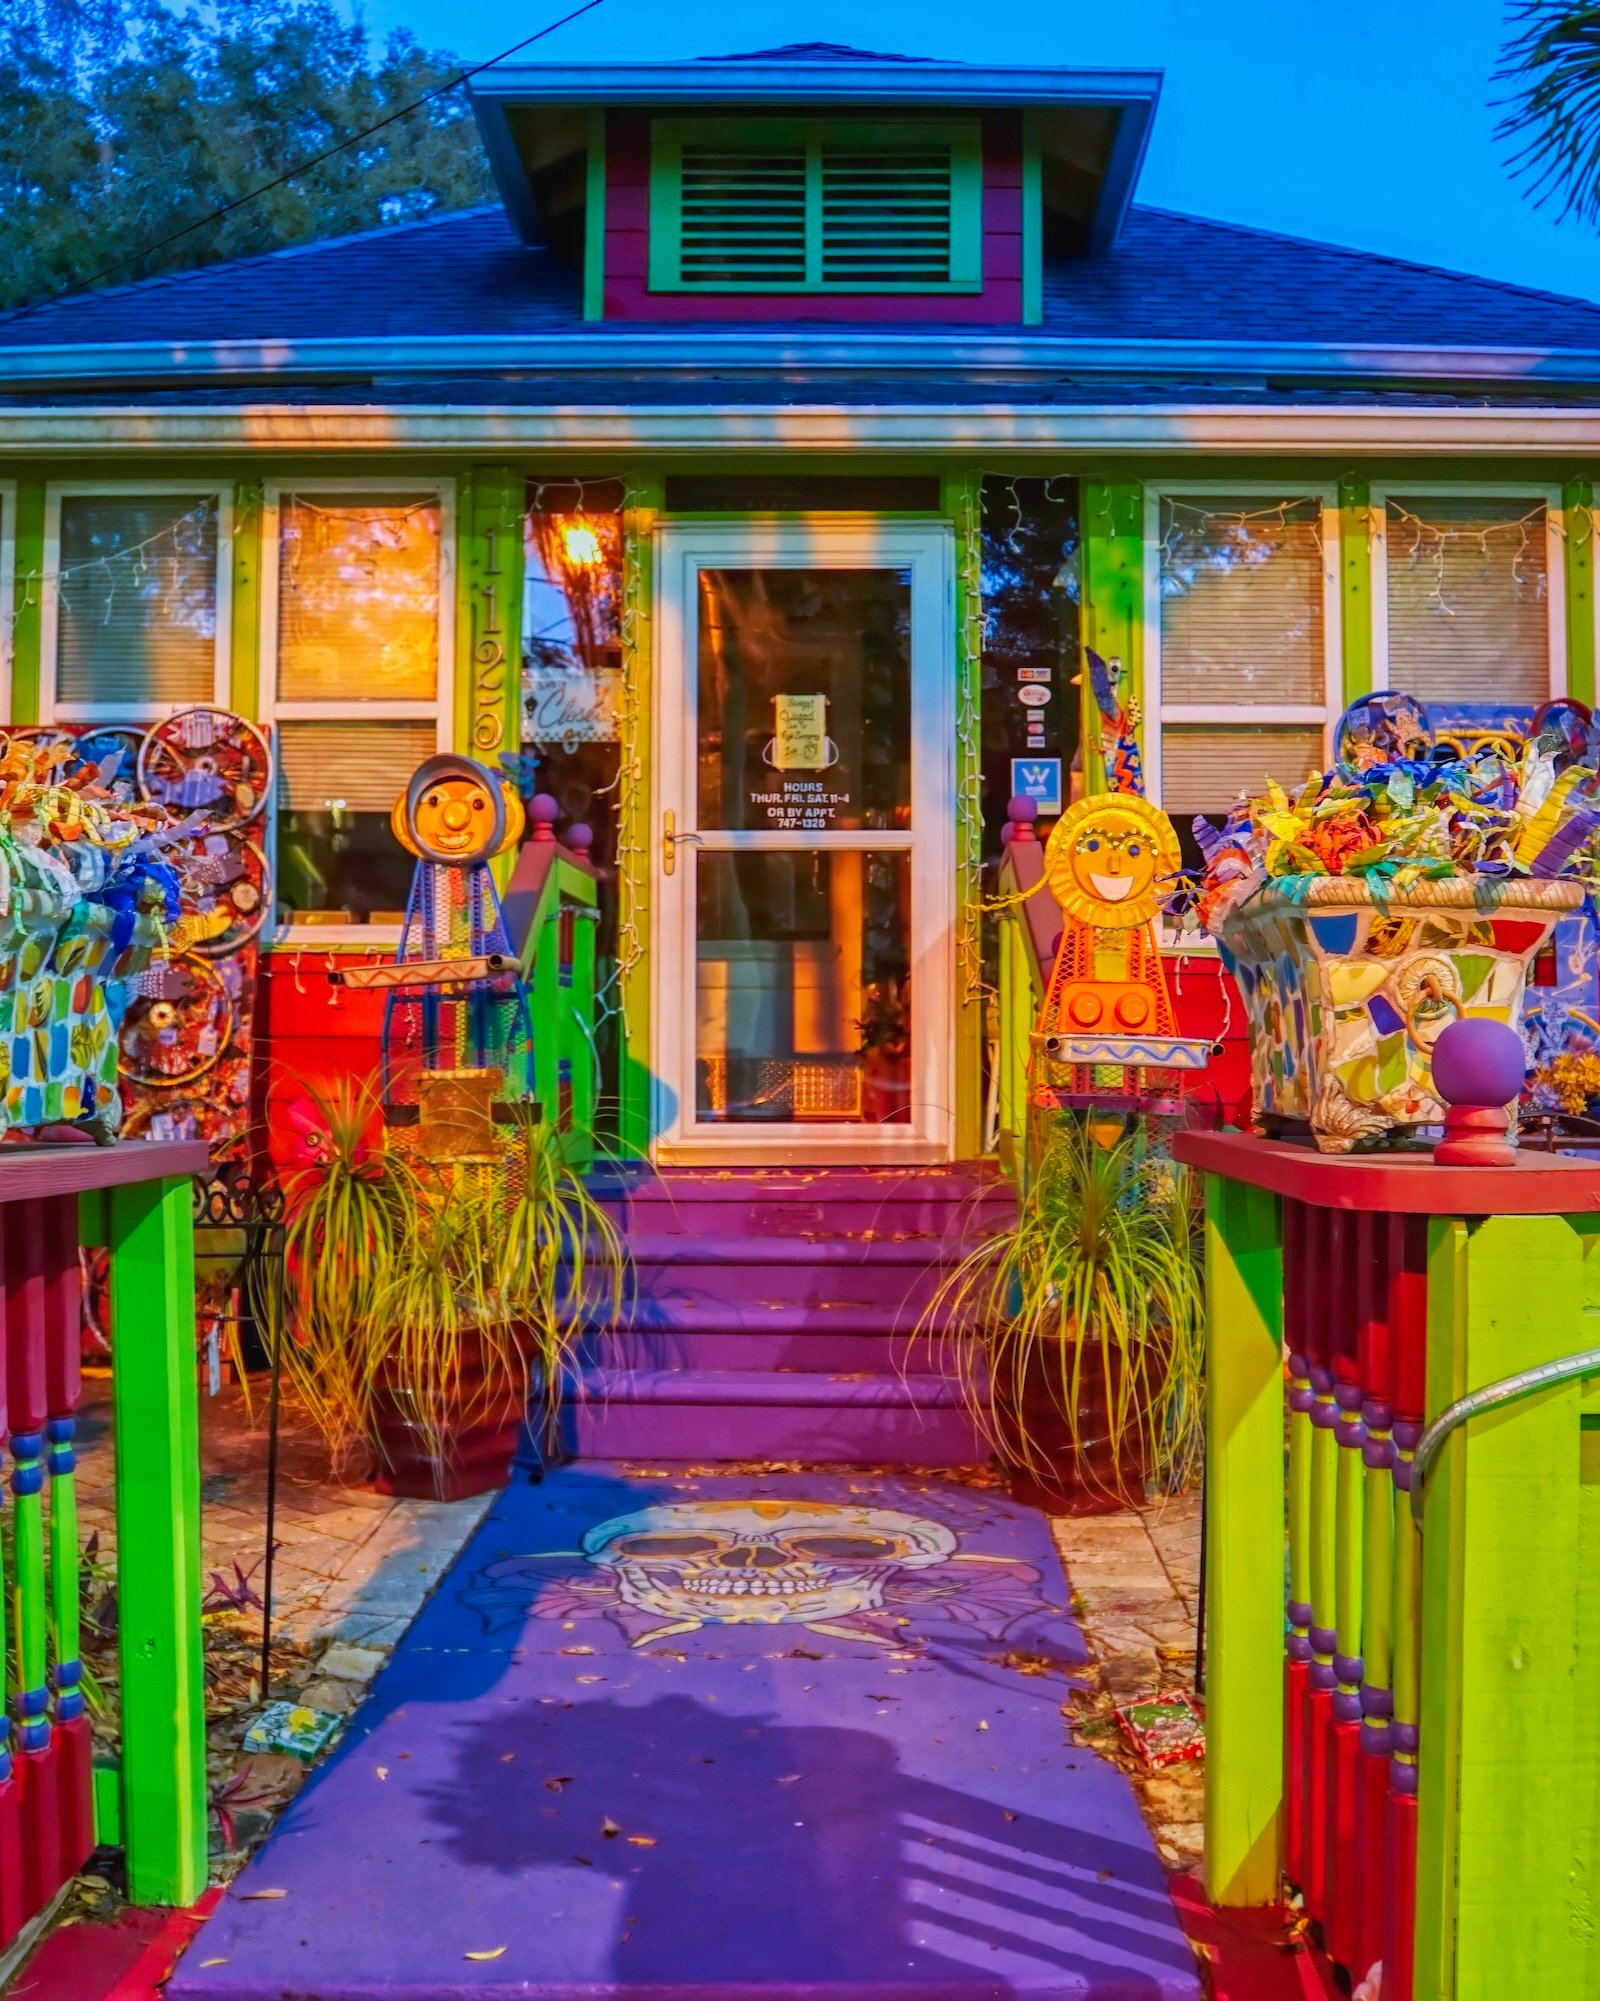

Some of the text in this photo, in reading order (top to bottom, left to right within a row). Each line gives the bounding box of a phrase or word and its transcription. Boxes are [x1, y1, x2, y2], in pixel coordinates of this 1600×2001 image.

[783, 782, 823, 792] HOURS
[767, 807, 836, 818] OR BY APPT.
[778, 818, 826, 828] 747-1320
